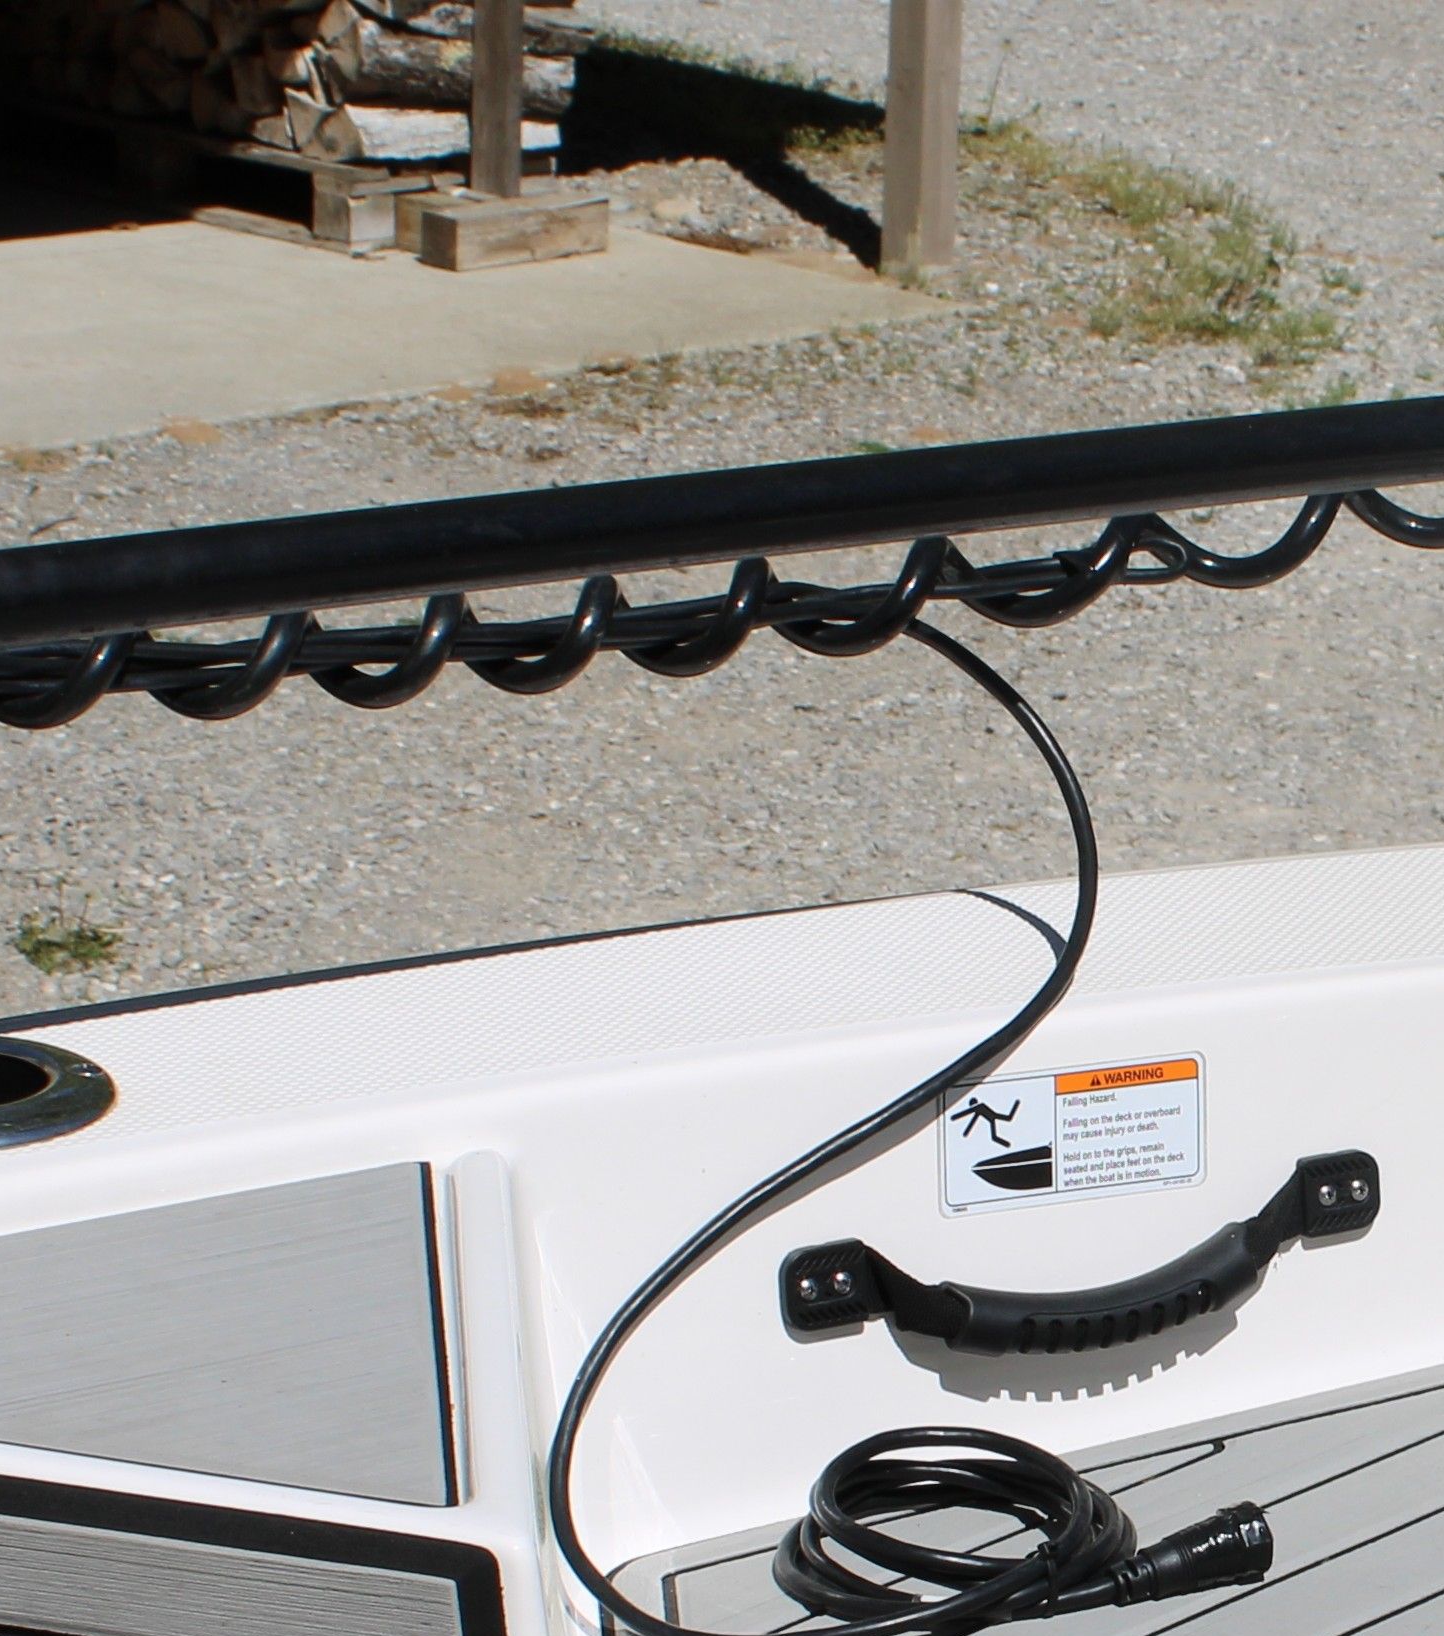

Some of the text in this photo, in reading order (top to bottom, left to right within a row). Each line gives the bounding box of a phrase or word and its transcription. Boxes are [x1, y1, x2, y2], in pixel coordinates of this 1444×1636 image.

[1104, 1067, 1164, 1085] WARNING
[1062, 1097, 1088, 1107] Falling
[1062, 1118, 1088, 1128] Falling
[1101, 1115, 1113, 1123] the
[1114, 1111, 1132, 1121] deck
[1144, 1105, 1181, 1117] overboard
[1063, 1132, 1079, 1141] may
[1081, 1129, 1103, 1138] cause
[1063, 1151, 1081, 1161] Hold
[1103, 1148, 1115, 1157] the
[1139, 1142, 1164, 1153] remain
[1064, 1163, 1088, 1175] seated
[1090, 1161, 1104, 1171] and
[1106, 1159, 1125, 1171] place
[1153, 1154, 1165, 1163] the
[1167, 1152, 1185, 1162] deck
[1064, 1177, 1083, 1187] when
[1085, 1175, 1097, 1184] the
[1099, 1172, 1115, 1183] boat
